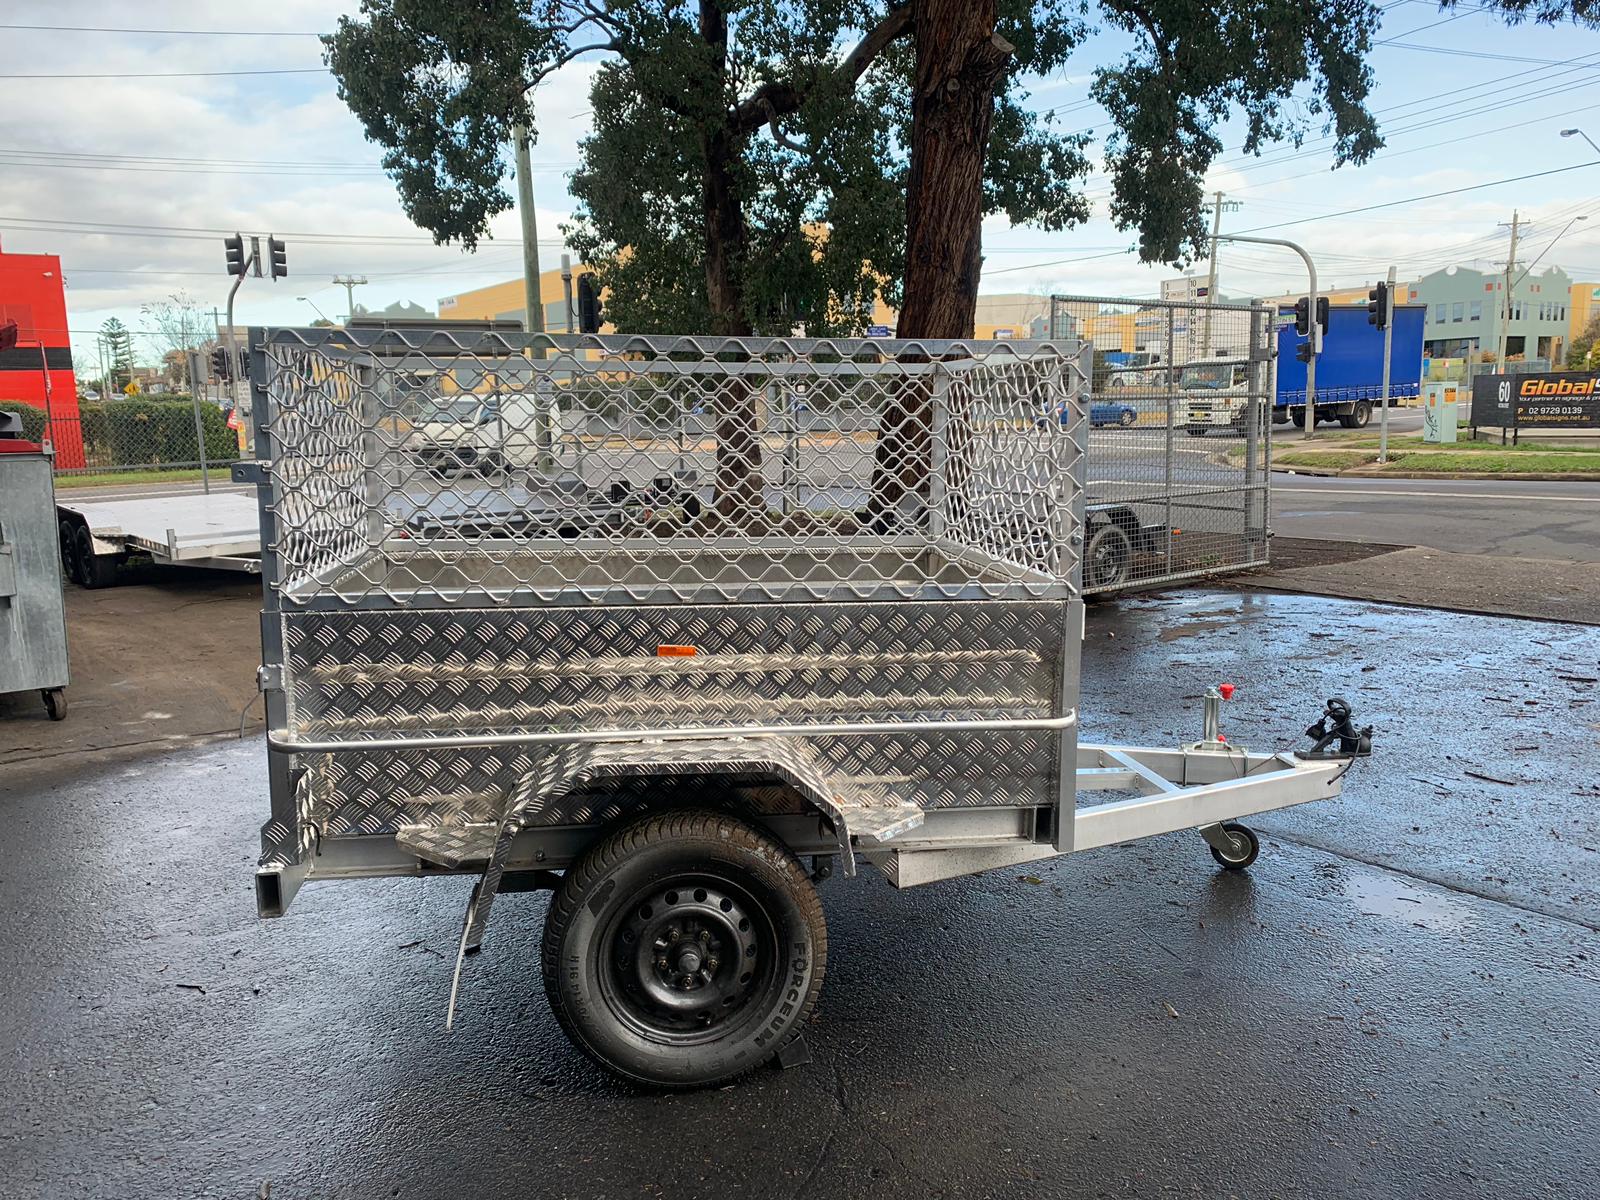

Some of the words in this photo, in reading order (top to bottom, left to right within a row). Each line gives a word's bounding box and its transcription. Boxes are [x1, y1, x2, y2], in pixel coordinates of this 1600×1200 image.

[1499, 381, 1510, 402] 60
[1562, 406, 1582, 414] 0139
[754, 942, 808, 1048] FORCEUM
